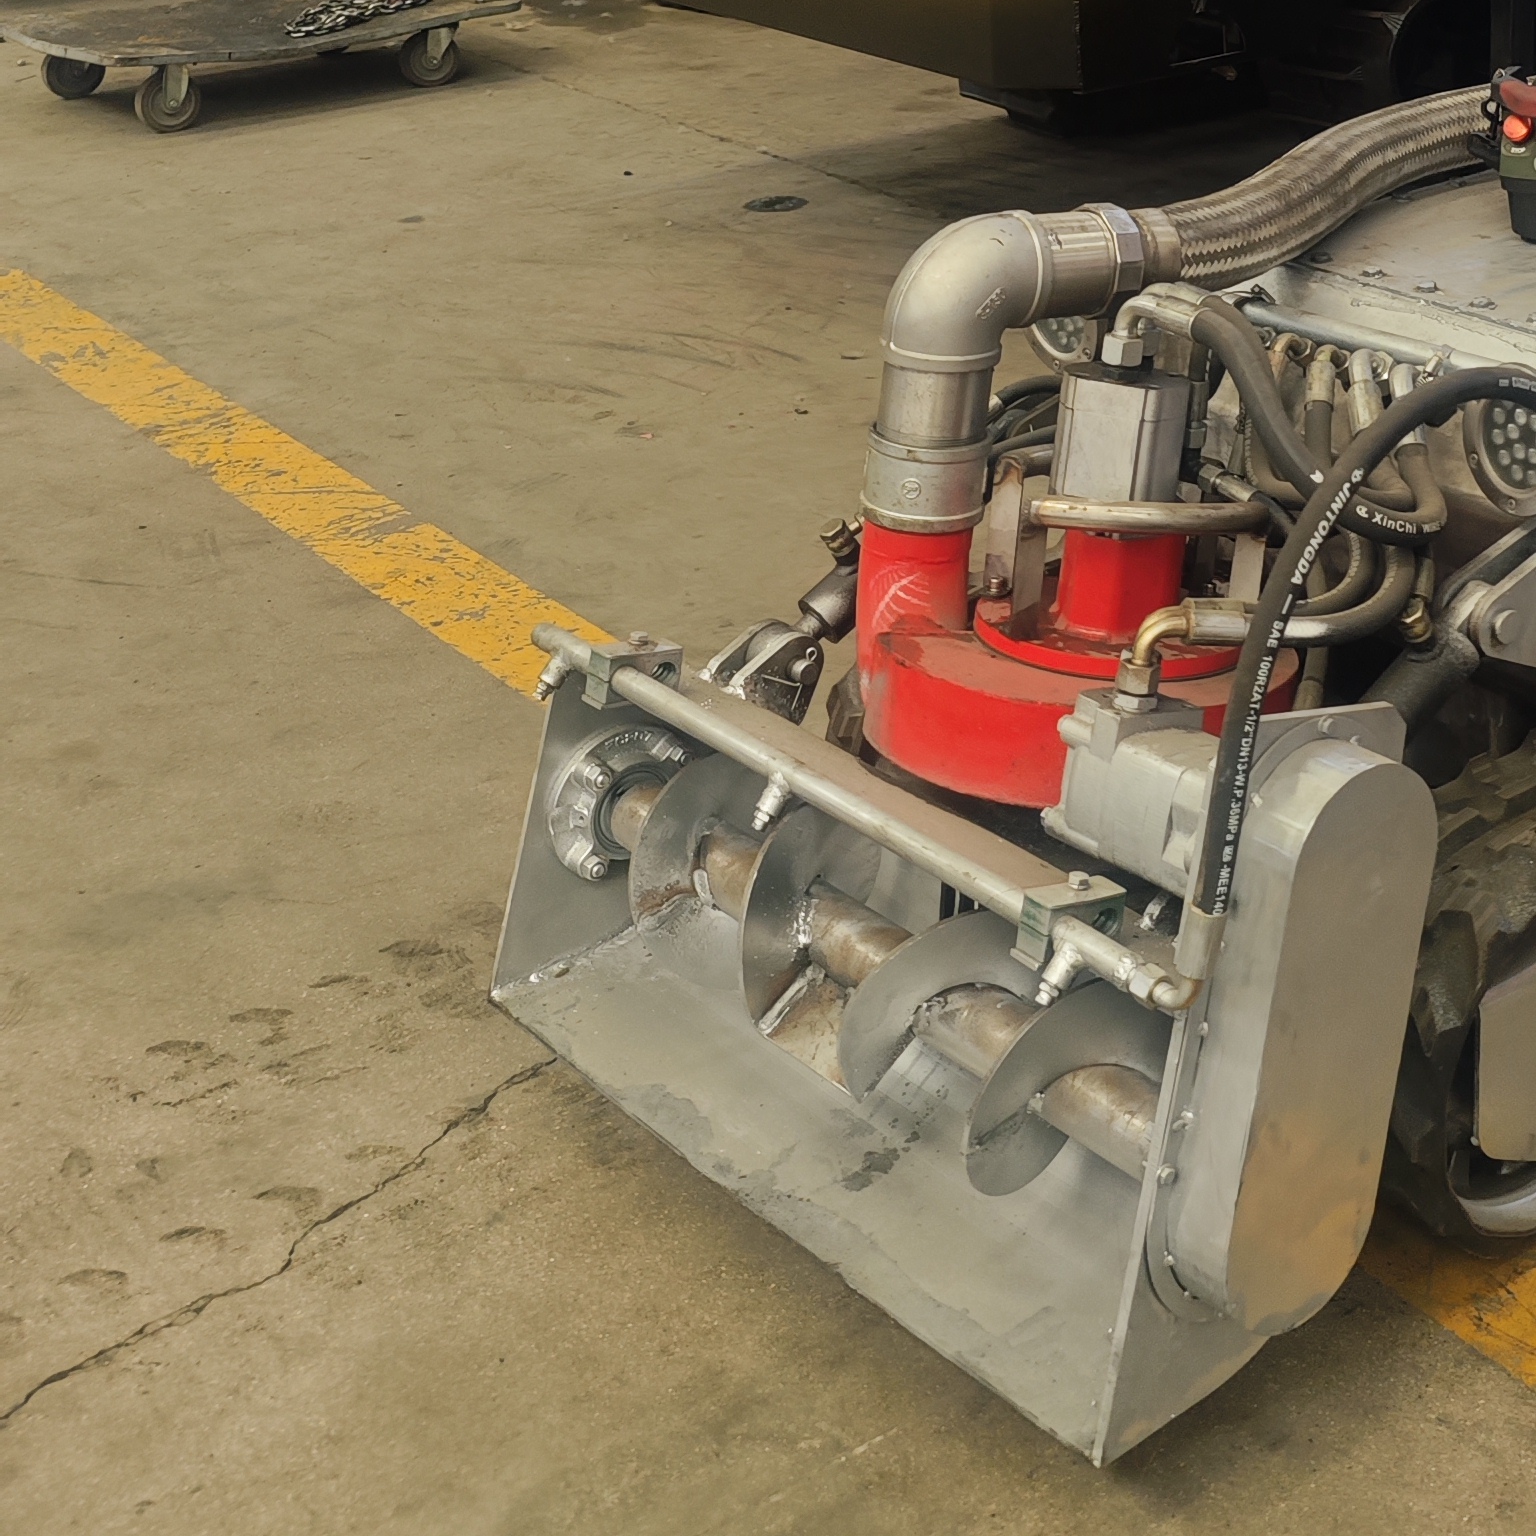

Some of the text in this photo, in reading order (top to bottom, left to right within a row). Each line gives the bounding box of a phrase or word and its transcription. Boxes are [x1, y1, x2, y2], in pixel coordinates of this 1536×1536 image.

[1290, 482, 1352, 586] JINTONGDA
[1371, 511, 1417, 535] XinChi
[1266, 620, 1285, 649] SAE
